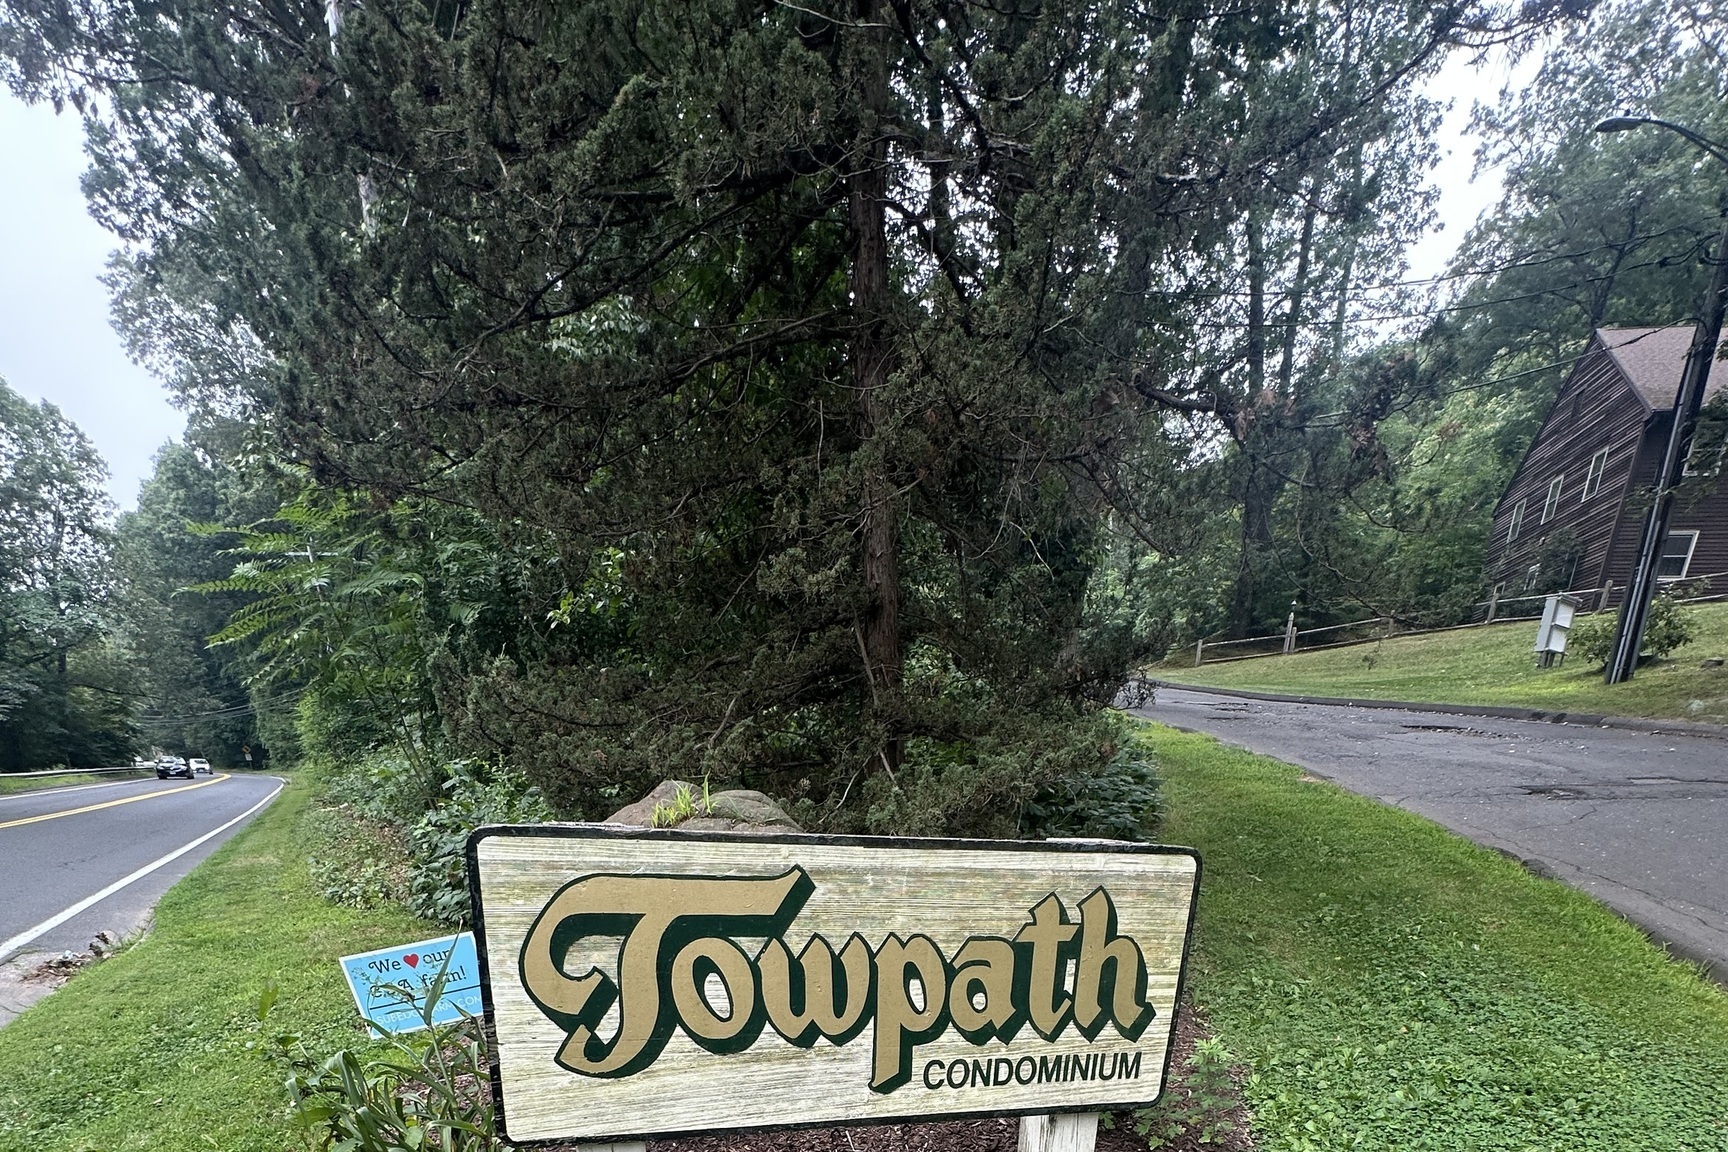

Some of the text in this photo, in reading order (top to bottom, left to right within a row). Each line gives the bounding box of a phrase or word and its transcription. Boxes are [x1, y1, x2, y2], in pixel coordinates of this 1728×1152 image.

[368, 949, 452, 974] We our
[518, 864, 1156, 1094] Towpath
[370, 965, 467, 998] CA fam!
[923, 1051, 1143, 1090] CONDOMINIUM
